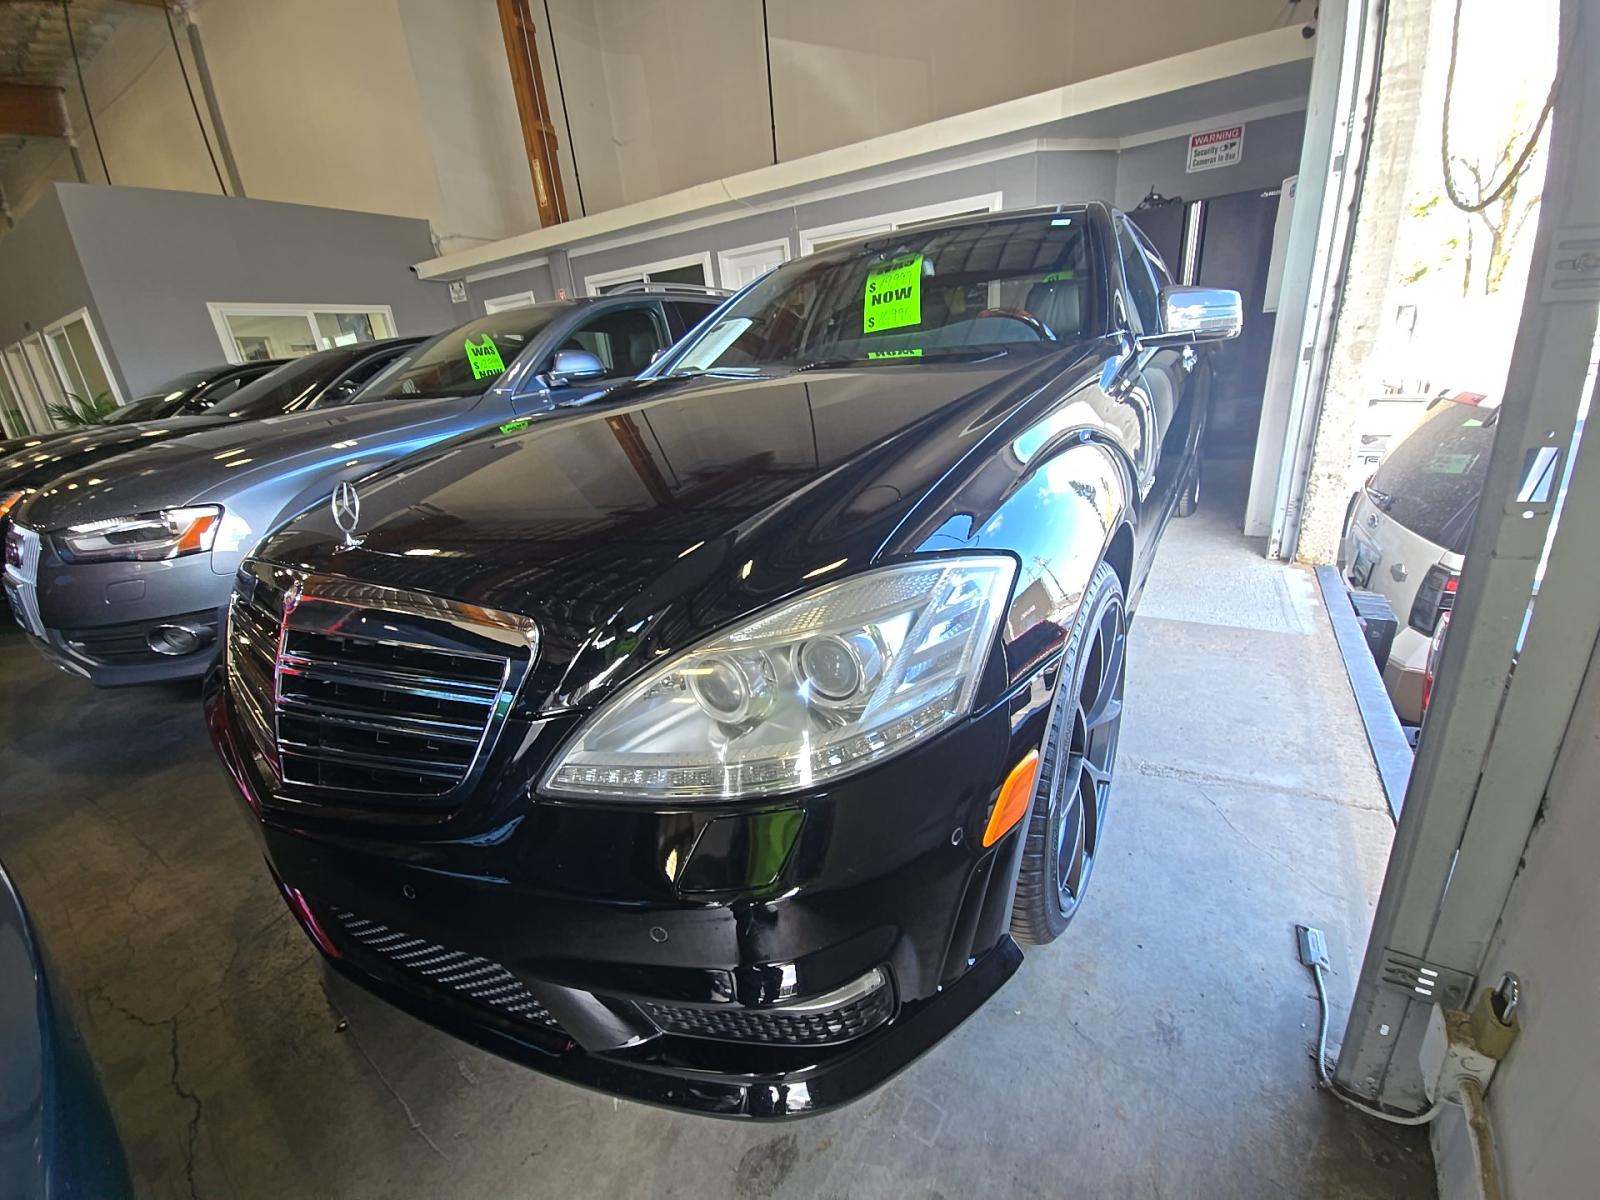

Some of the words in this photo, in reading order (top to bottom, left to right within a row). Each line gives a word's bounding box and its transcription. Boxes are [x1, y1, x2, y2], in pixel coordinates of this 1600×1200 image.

[1194, 128, 1239, 145] WARNING
[1194, 146, 1218, 157] Security
[1193, 157, 1216, 167] Cameras
[872, 286, 912, 306] NOW
[868, 316, 875, 328] $
[471, 346, 496, 356] WAS
